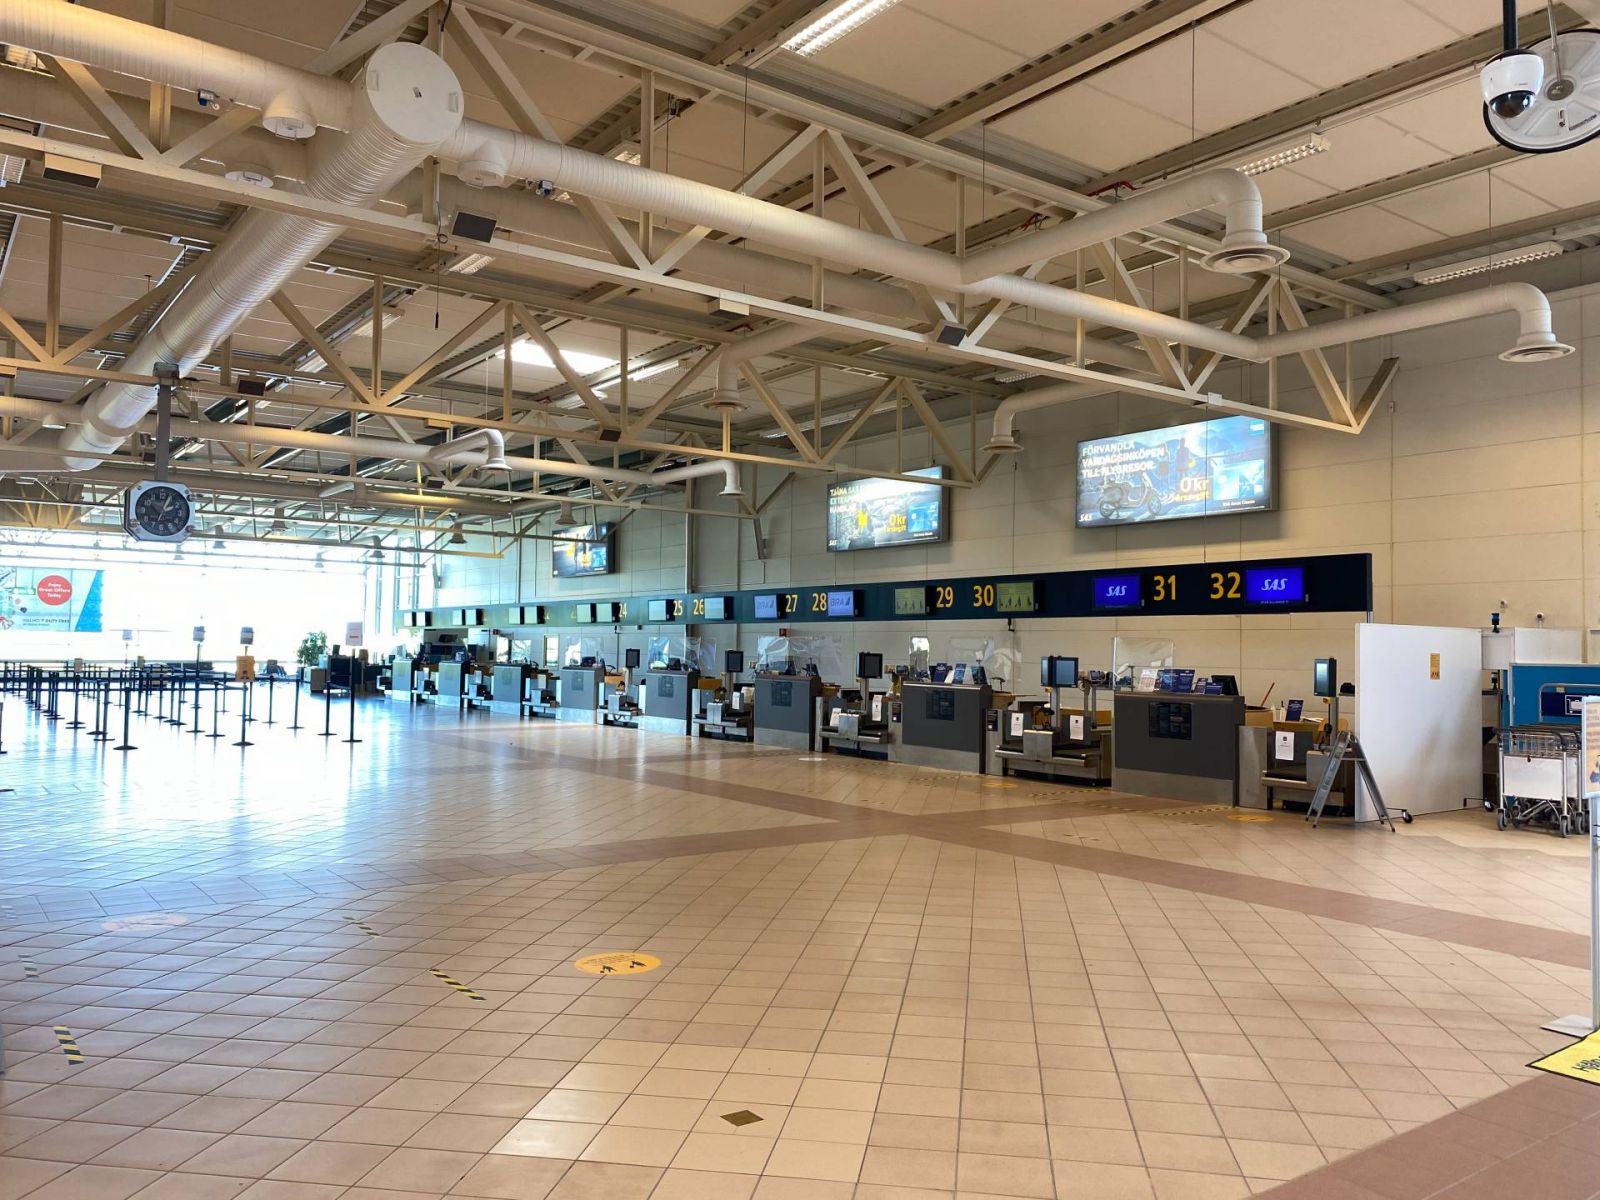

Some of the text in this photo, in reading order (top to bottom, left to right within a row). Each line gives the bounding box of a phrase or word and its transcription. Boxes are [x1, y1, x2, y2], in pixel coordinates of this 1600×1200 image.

[1082, 440, 1136, 456] FÖRVANDLA
[1082, 446, 1166, 468] VARDAGSINKÖPEN
[1180, 477, 1209, 493] 0 kr
[1079, 514, 1092, 522] SAS
[1106, 585, 1127, 597] SAS
[1153, 574, 1176, 601] 31
[1210, 571, 1241, 599] 32
[1261, 578, 1288, 591] SAS
[785, 594, 798, 613] 27
[812, 592, 827, 612] 28
[830, 599, 844, 607] BRA
[936, 586, 954, 608] 29
[973, 584, 994, 607] 30
[618, 603, 627, 618] 24
[673, 600, 683, 616] 25
[693, 599, 704, 615] 26
